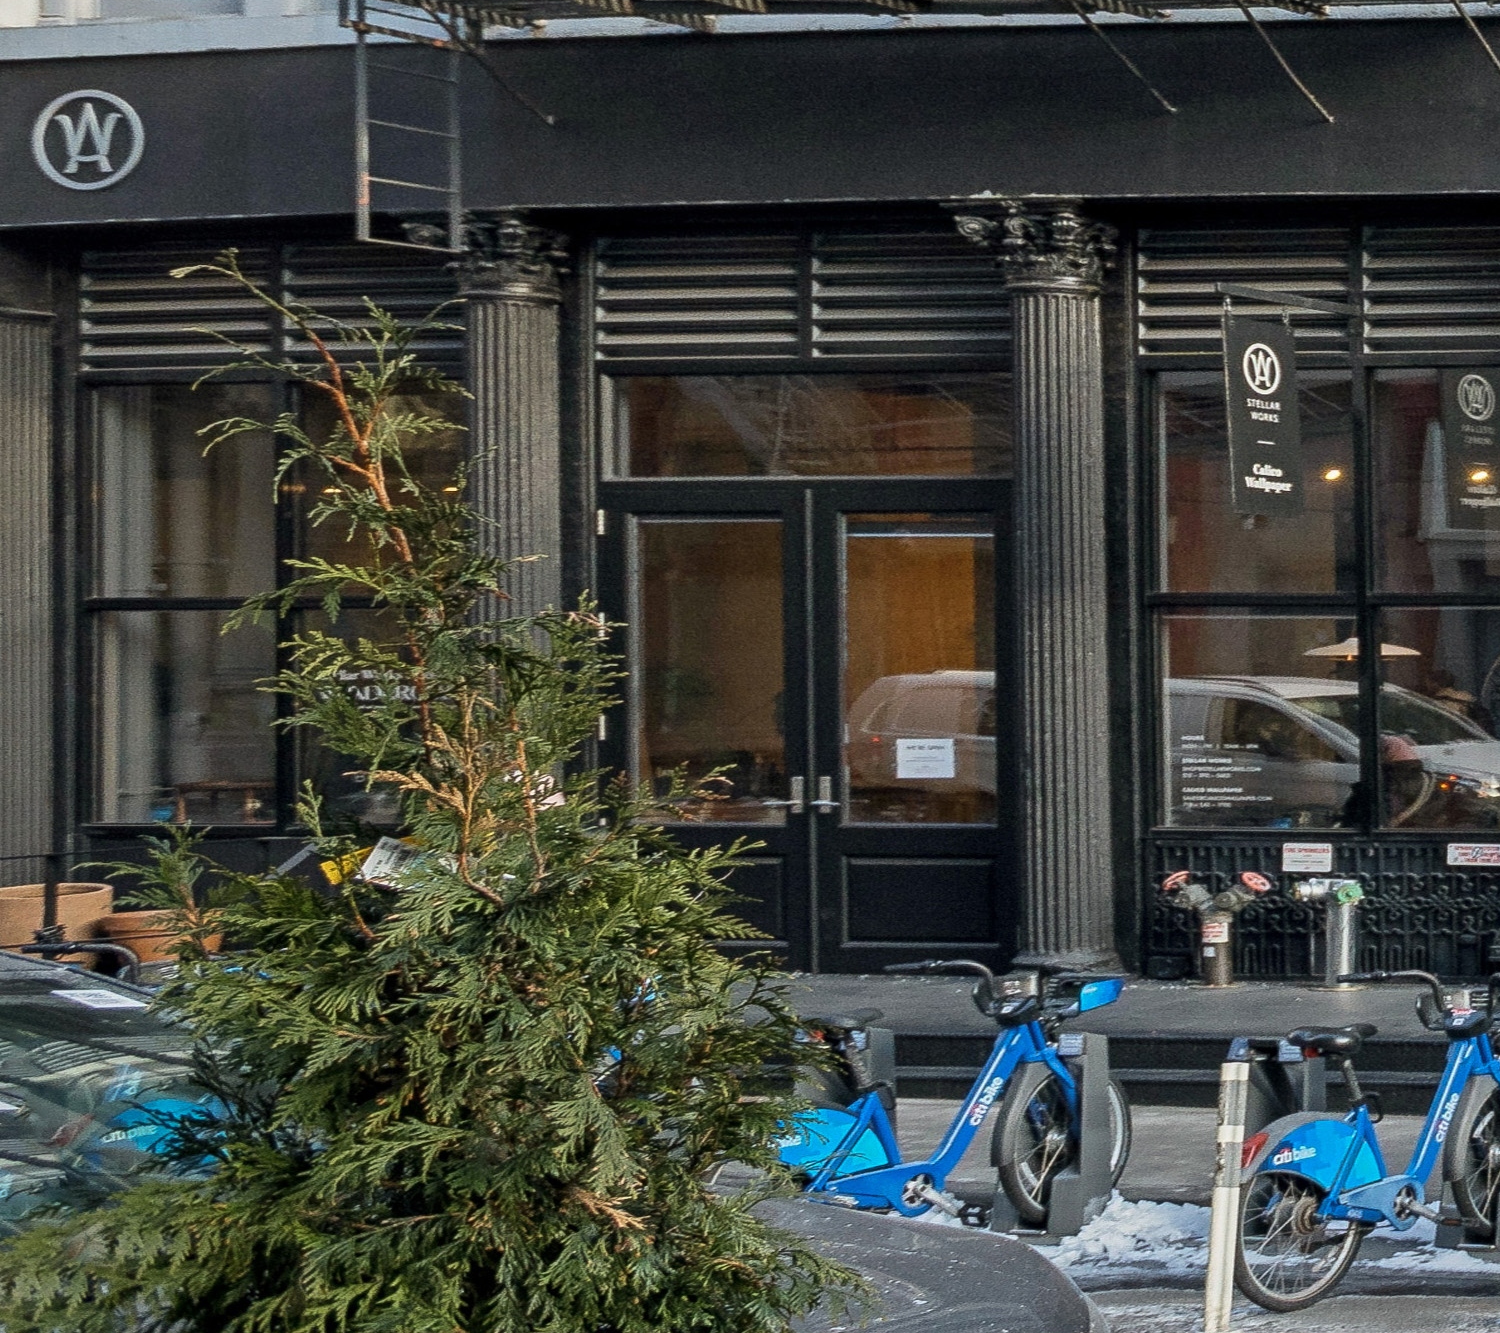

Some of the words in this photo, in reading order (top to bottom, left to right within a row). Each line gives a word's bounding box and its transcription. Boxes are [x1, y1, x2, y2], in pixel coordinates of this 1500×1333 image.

[1246, 398, 1281, 411] STELLAR
[1250, 411, 1280, 423] WORKS
[1252, 463, 1284, 478] Calico
[1245, 476, 1293, 494] Wallpaper
[1273, 1148, 1293, 1166] citi
[1292, 1145, 1317, 1161] bike
